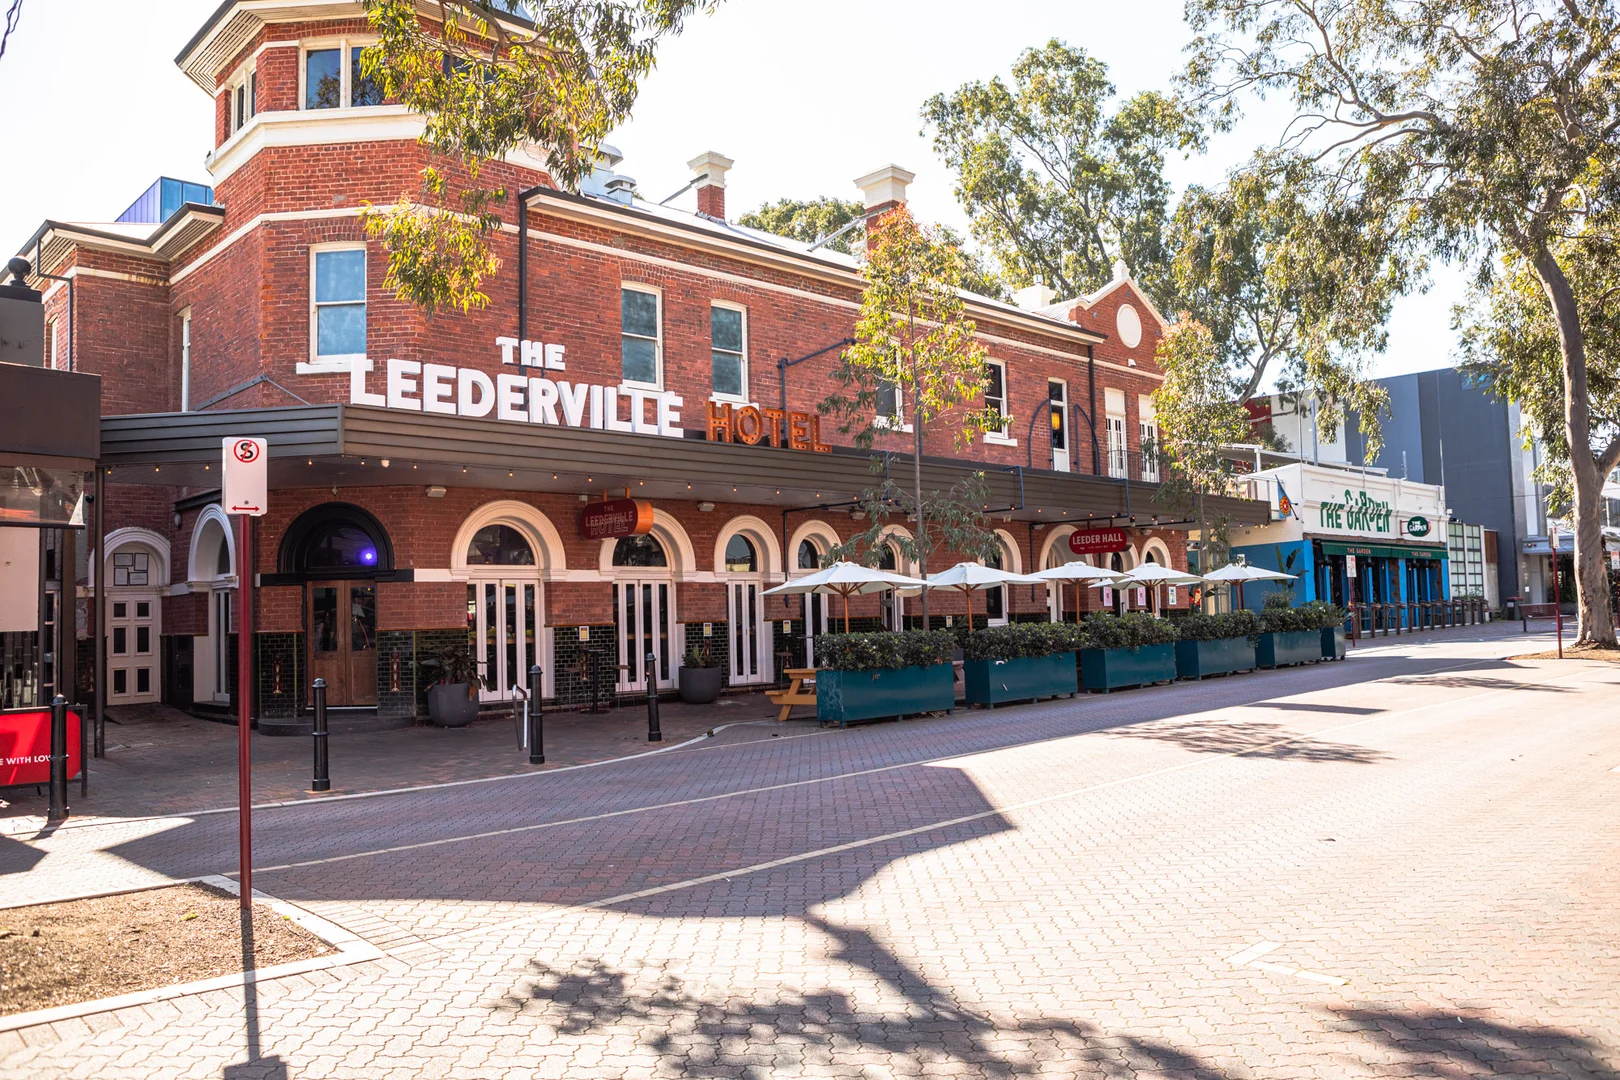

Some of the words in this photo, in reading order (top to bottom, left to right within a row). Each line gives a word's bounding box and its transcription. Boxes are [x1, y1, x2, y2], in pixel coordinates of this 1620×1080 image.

[495, 336, 566, 371] THE
[349, 353, 684, 438] LEEDERVILLE
[706, 400, 833, 454] HOTEL
[585, 511, 634, 528] LEEDERVILLE
[1320, 502, 1345, 529] THE
[1344, 489, 1393, 533] GARDEN
[590, 518, 629, 536] HOTEL
[1072, 534, 1101, 545] LEEDER
[1102, 532, 1123, 543] HALL
[6, 756, 31, 765] WITH
[34, 754, 51, 763] LOV
